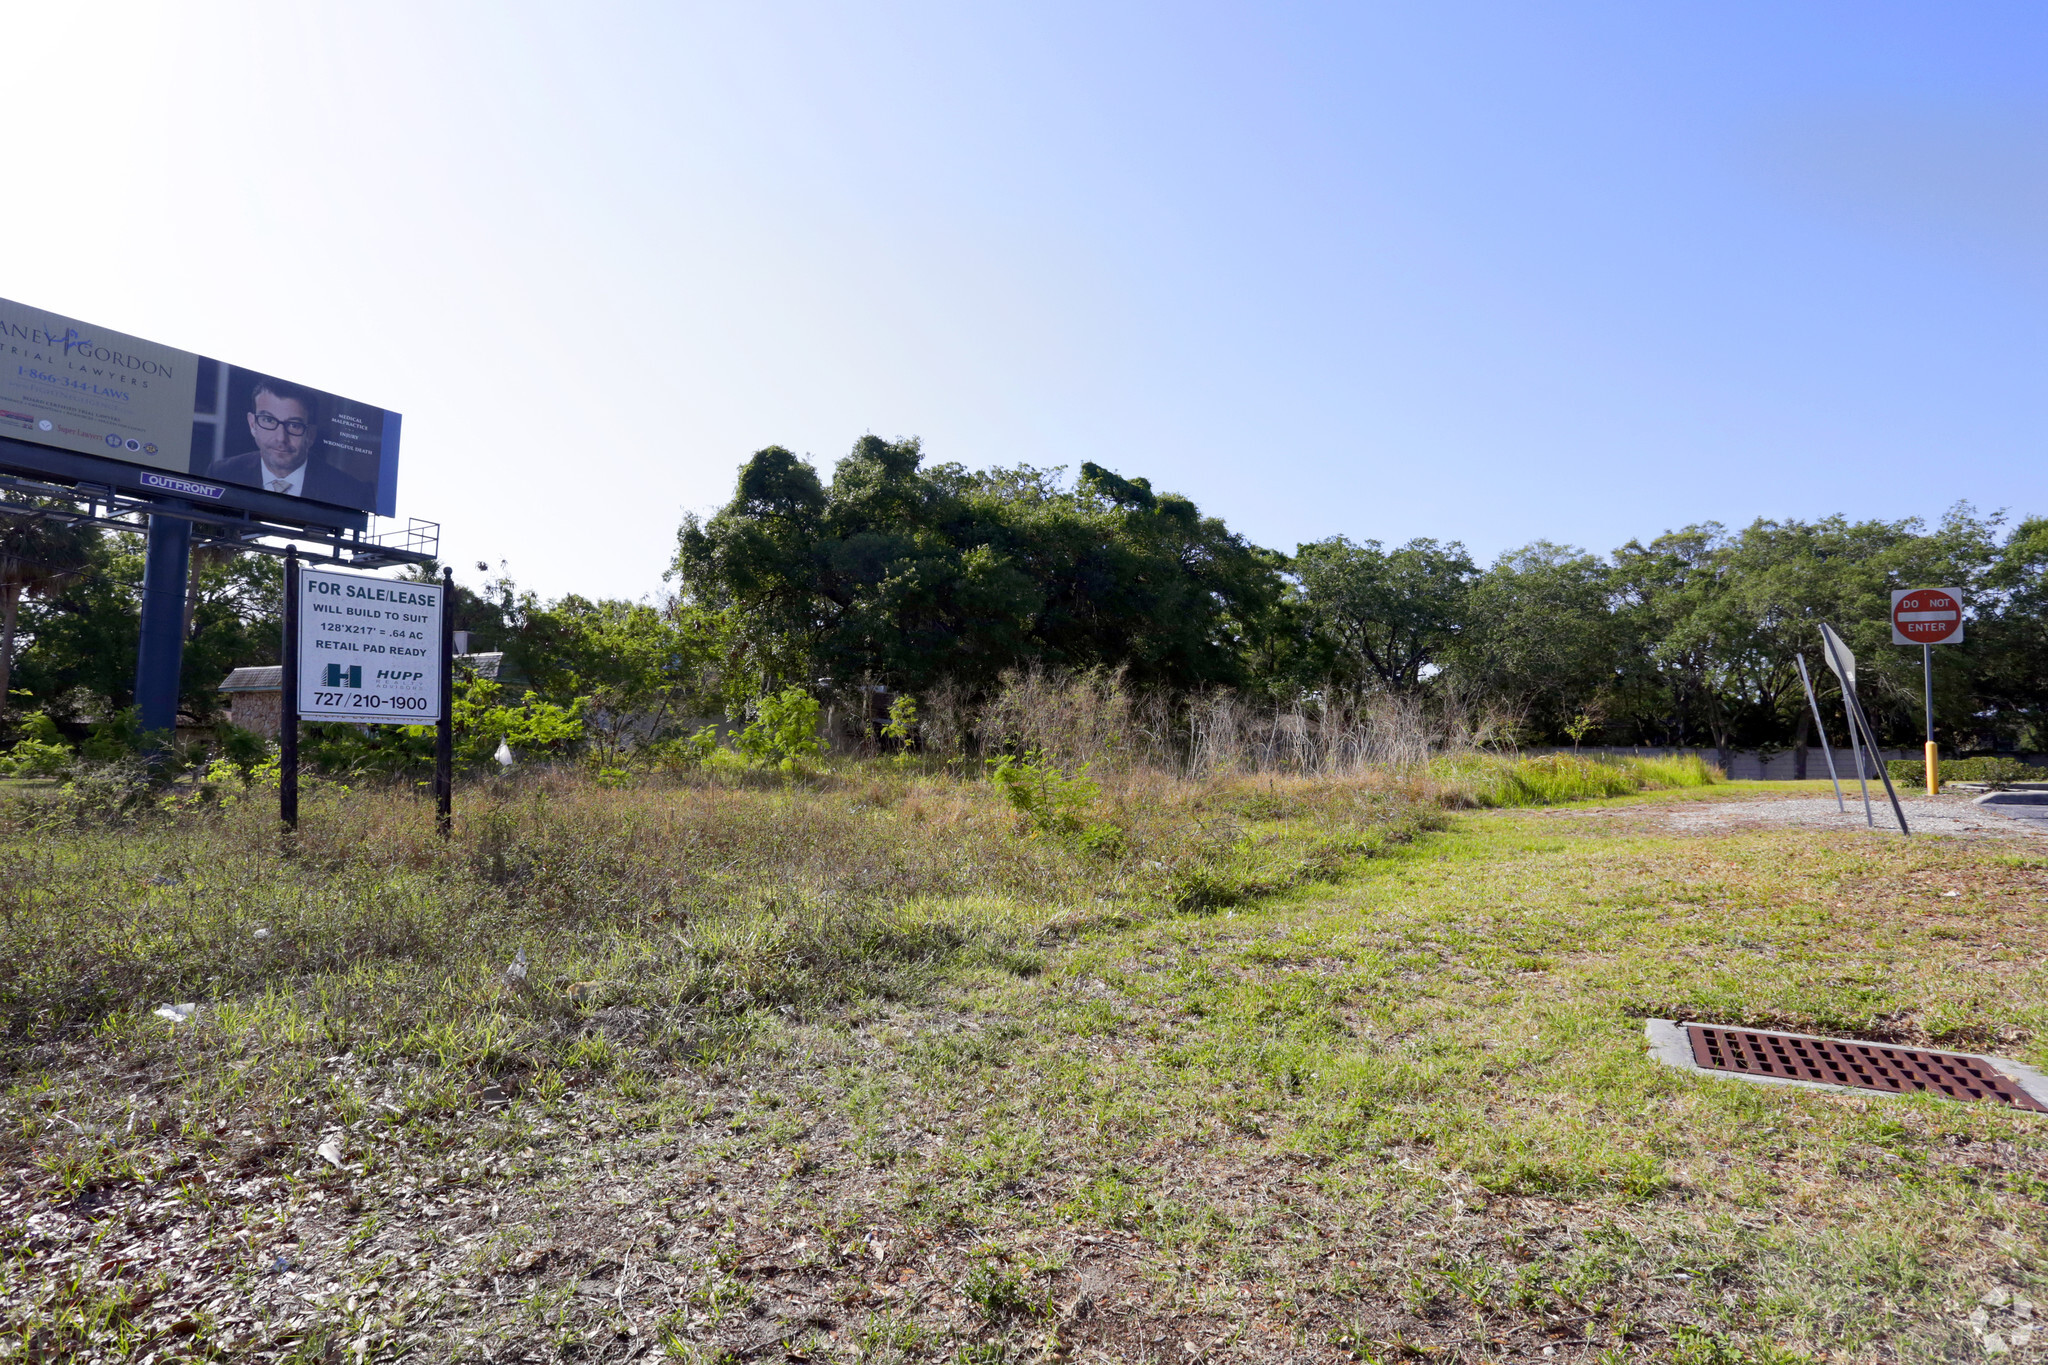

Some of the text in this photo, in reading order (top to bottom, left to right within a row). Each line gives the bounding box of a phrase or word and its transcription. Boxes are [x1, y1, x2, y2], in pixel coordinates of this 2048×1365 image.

[0, 343, 149, 389] TRIAL LAWYERS
[78, 343, 173, 379] GORDON
[18, 365, 130, 402] 1-866-344-LAWS
[331, 418, 368, 431] MALPRACTICE
[338, 414, 363, 423] MEDICAL
[57, 424, 103, 441] Super Lawyers
[339, 431, 359, 440] INJURY
[322, 439, 373, 455] WRONGFUL DEATH
[149, 476, 216, 496] OUTFRONT
[308, 580, 436, 607] FOR SALE/LEASE
[1903, 598, 1950, 609] DO NOT
[313, 603, 429, 623] WILL BUILD TO SUIT
[320, 622, 376, 635] 128'X217'
[389, 630, 406, 638] .64
[408, 631, 424, 640] AC
[1908, 622, 1946, 633] ENTER
[316, 640, 427, 657] RETAIL PAD READY
[376, 669, 424, 681] HUPP
